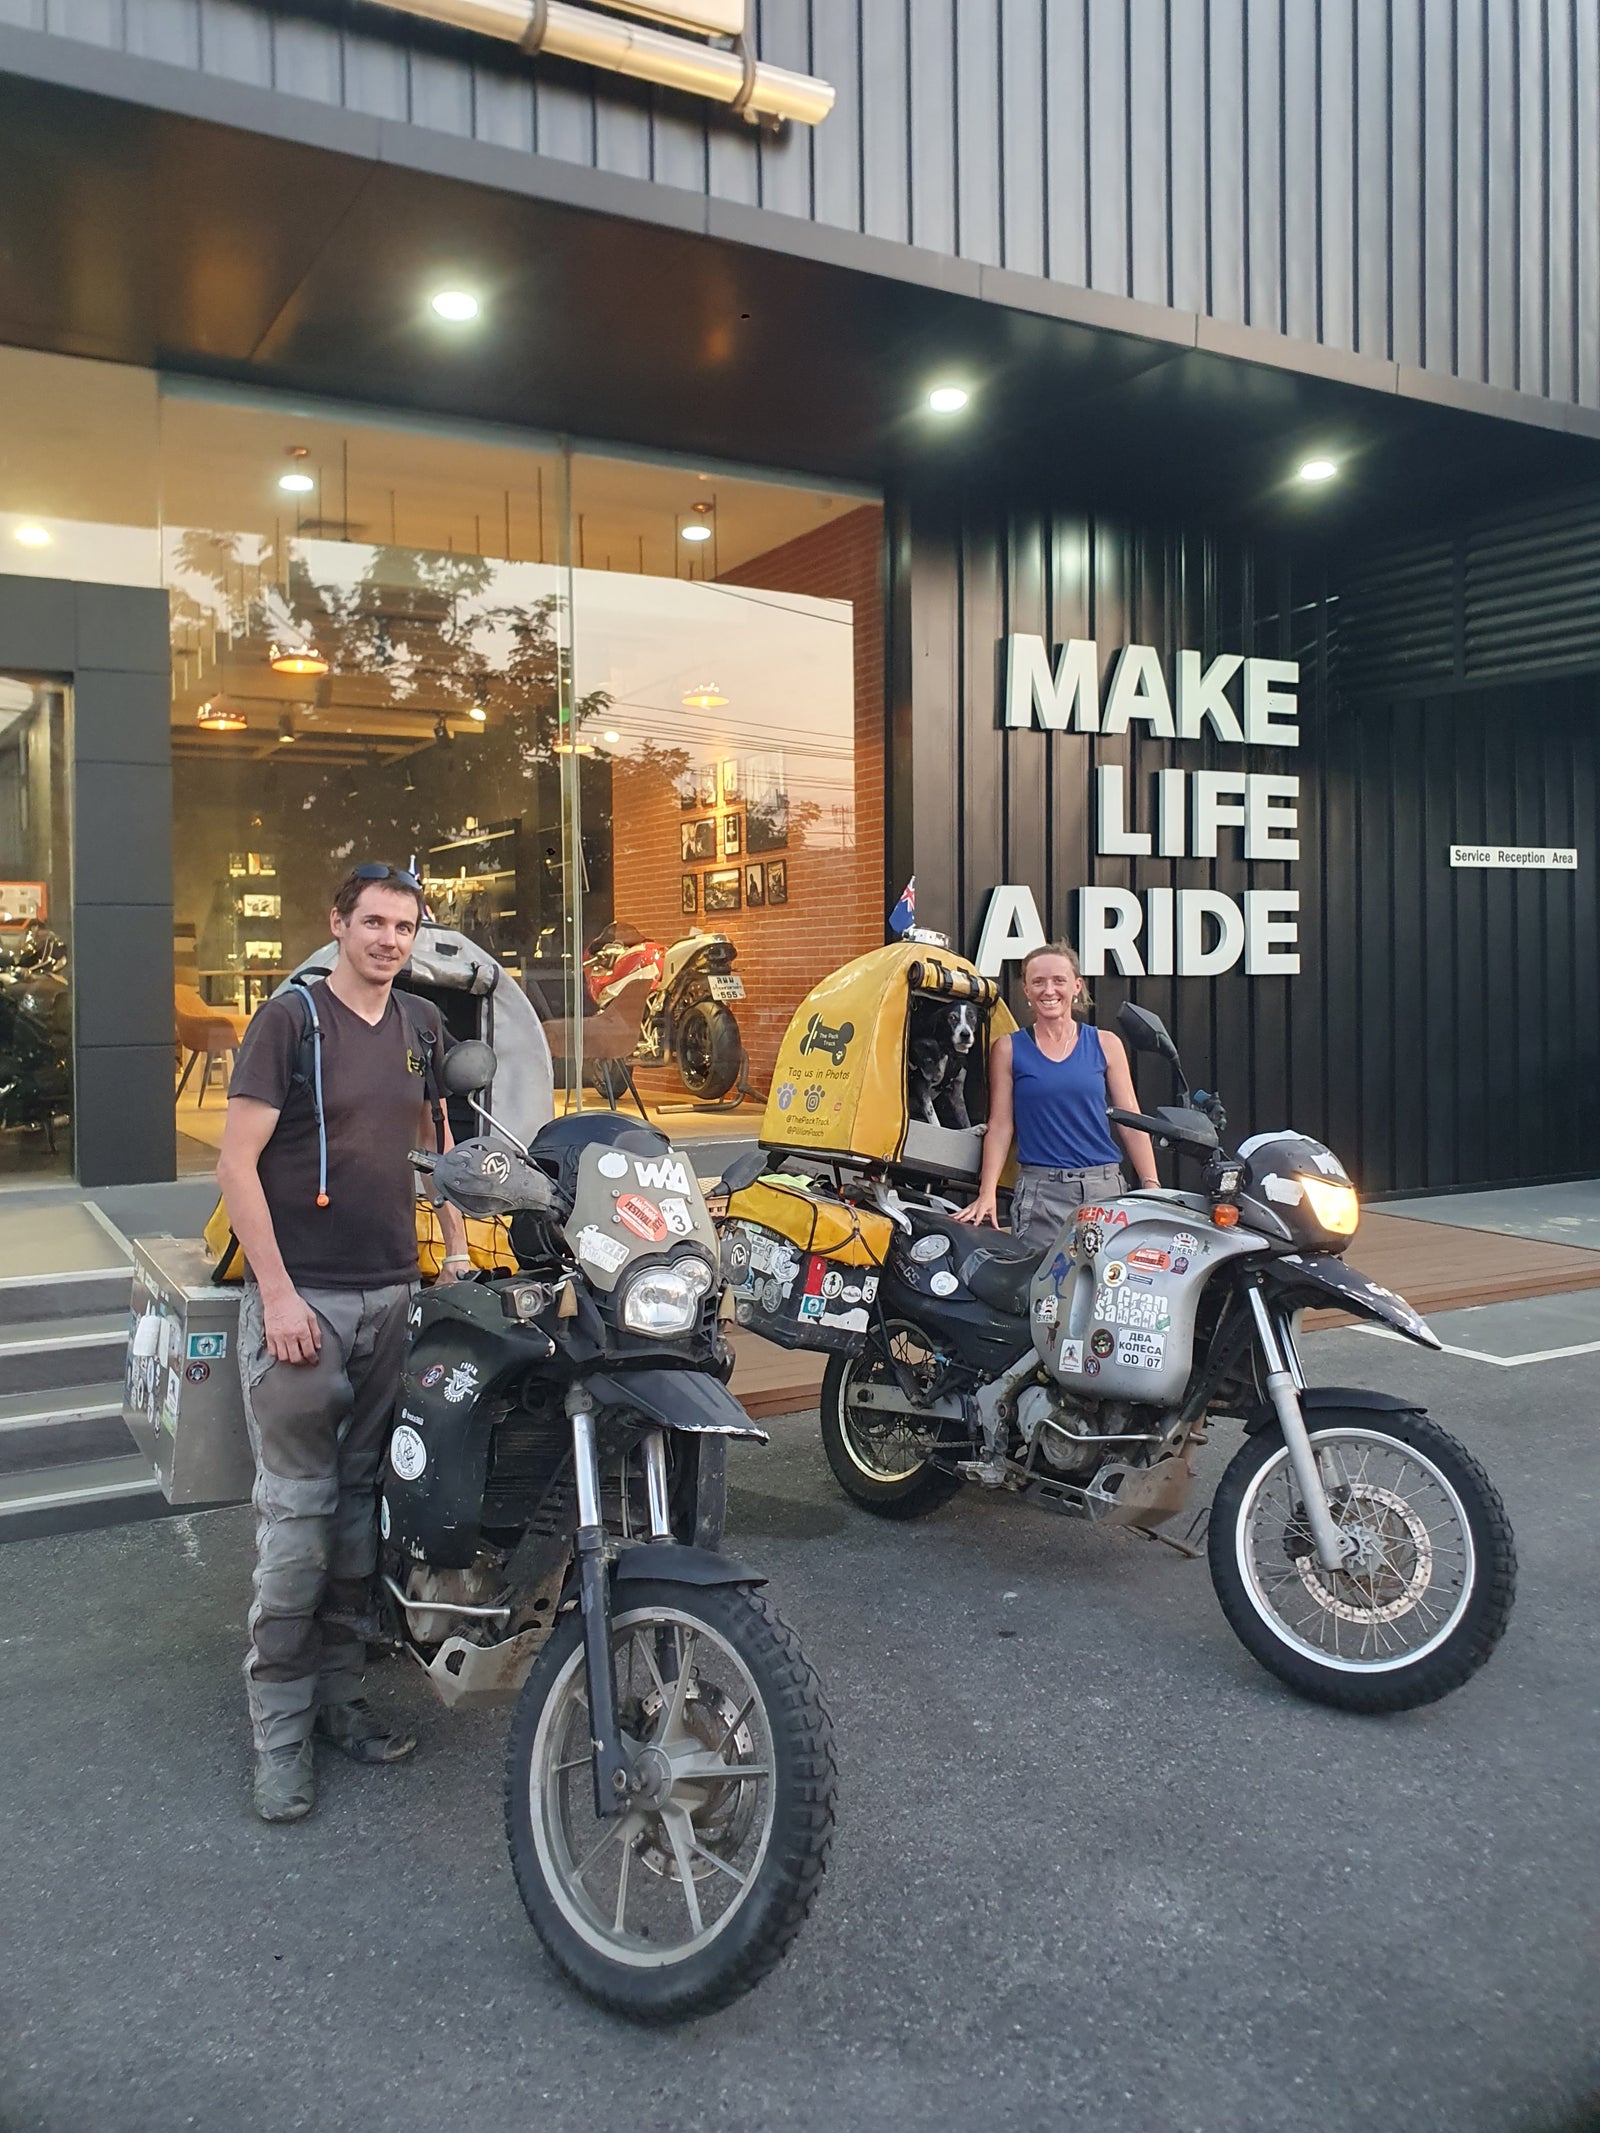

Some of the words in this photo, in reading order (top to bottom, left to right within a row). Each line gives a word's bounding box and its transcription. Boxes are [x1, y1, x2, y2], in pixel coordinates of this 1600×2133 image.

[1004, 632, 1300, 747] MAKE
[1097, 763, 1300, 860] LIFE
[1455, 849, 1491, 862] Service
[1498, 850, 1546, 865] Reception
[1552, 852, 1574, 864] Area
[975, 885, 1047, 977] A
[1078, 886, 1301, 977] RIDE
[789, 1067, 802, 1080] Tag
[804, 1070, 814, 1078] us
[816, 1068, 824, 1078] in
[825, 1069, 850, 1080] Photos
[624, 1201, 652, 1226] FESTIVAL
[1077, 1206, 1130, 1228] SENA
[672, 1214, 687, 1232] 3
[865, 1288, 874, 1301] 3
[1117, 1286, 1169, 1314] Gran
[1129, 1332, 1151, 1343] ДВА
[1119, 1341, 1162, 1356] КОЛЕСА
[1123, 1353, 1139, 1365] OD
[1147, 1357, 1161, 1368] 07
